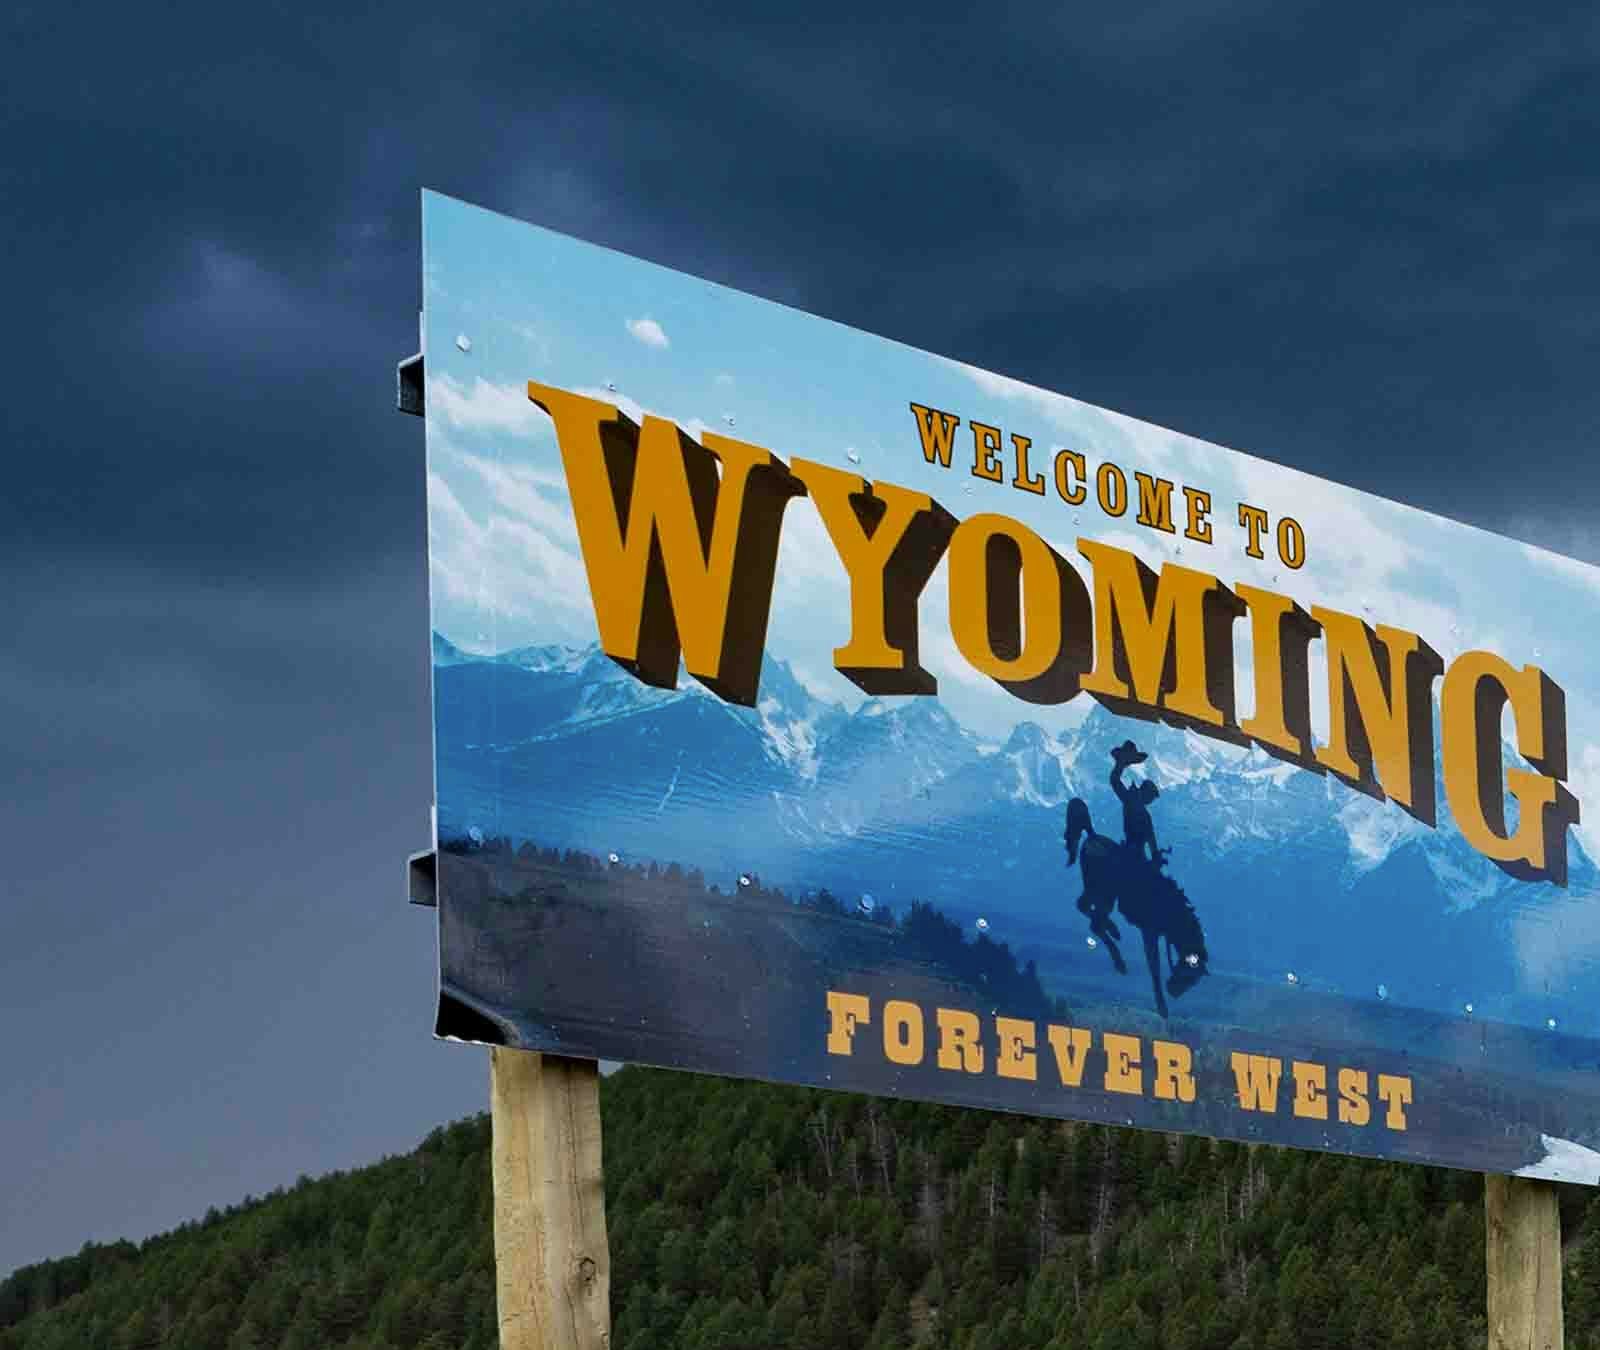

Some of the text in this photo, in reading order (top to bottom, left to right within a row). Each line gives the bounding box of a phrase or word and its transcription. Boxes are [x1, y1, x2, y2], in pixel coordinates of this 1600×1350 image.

[910, 402, 1306, 569] WELCOME TO
[527, 380, 1579, 888] WYOMING
[826, 991, 1413, 1130] FOREVER WEST
